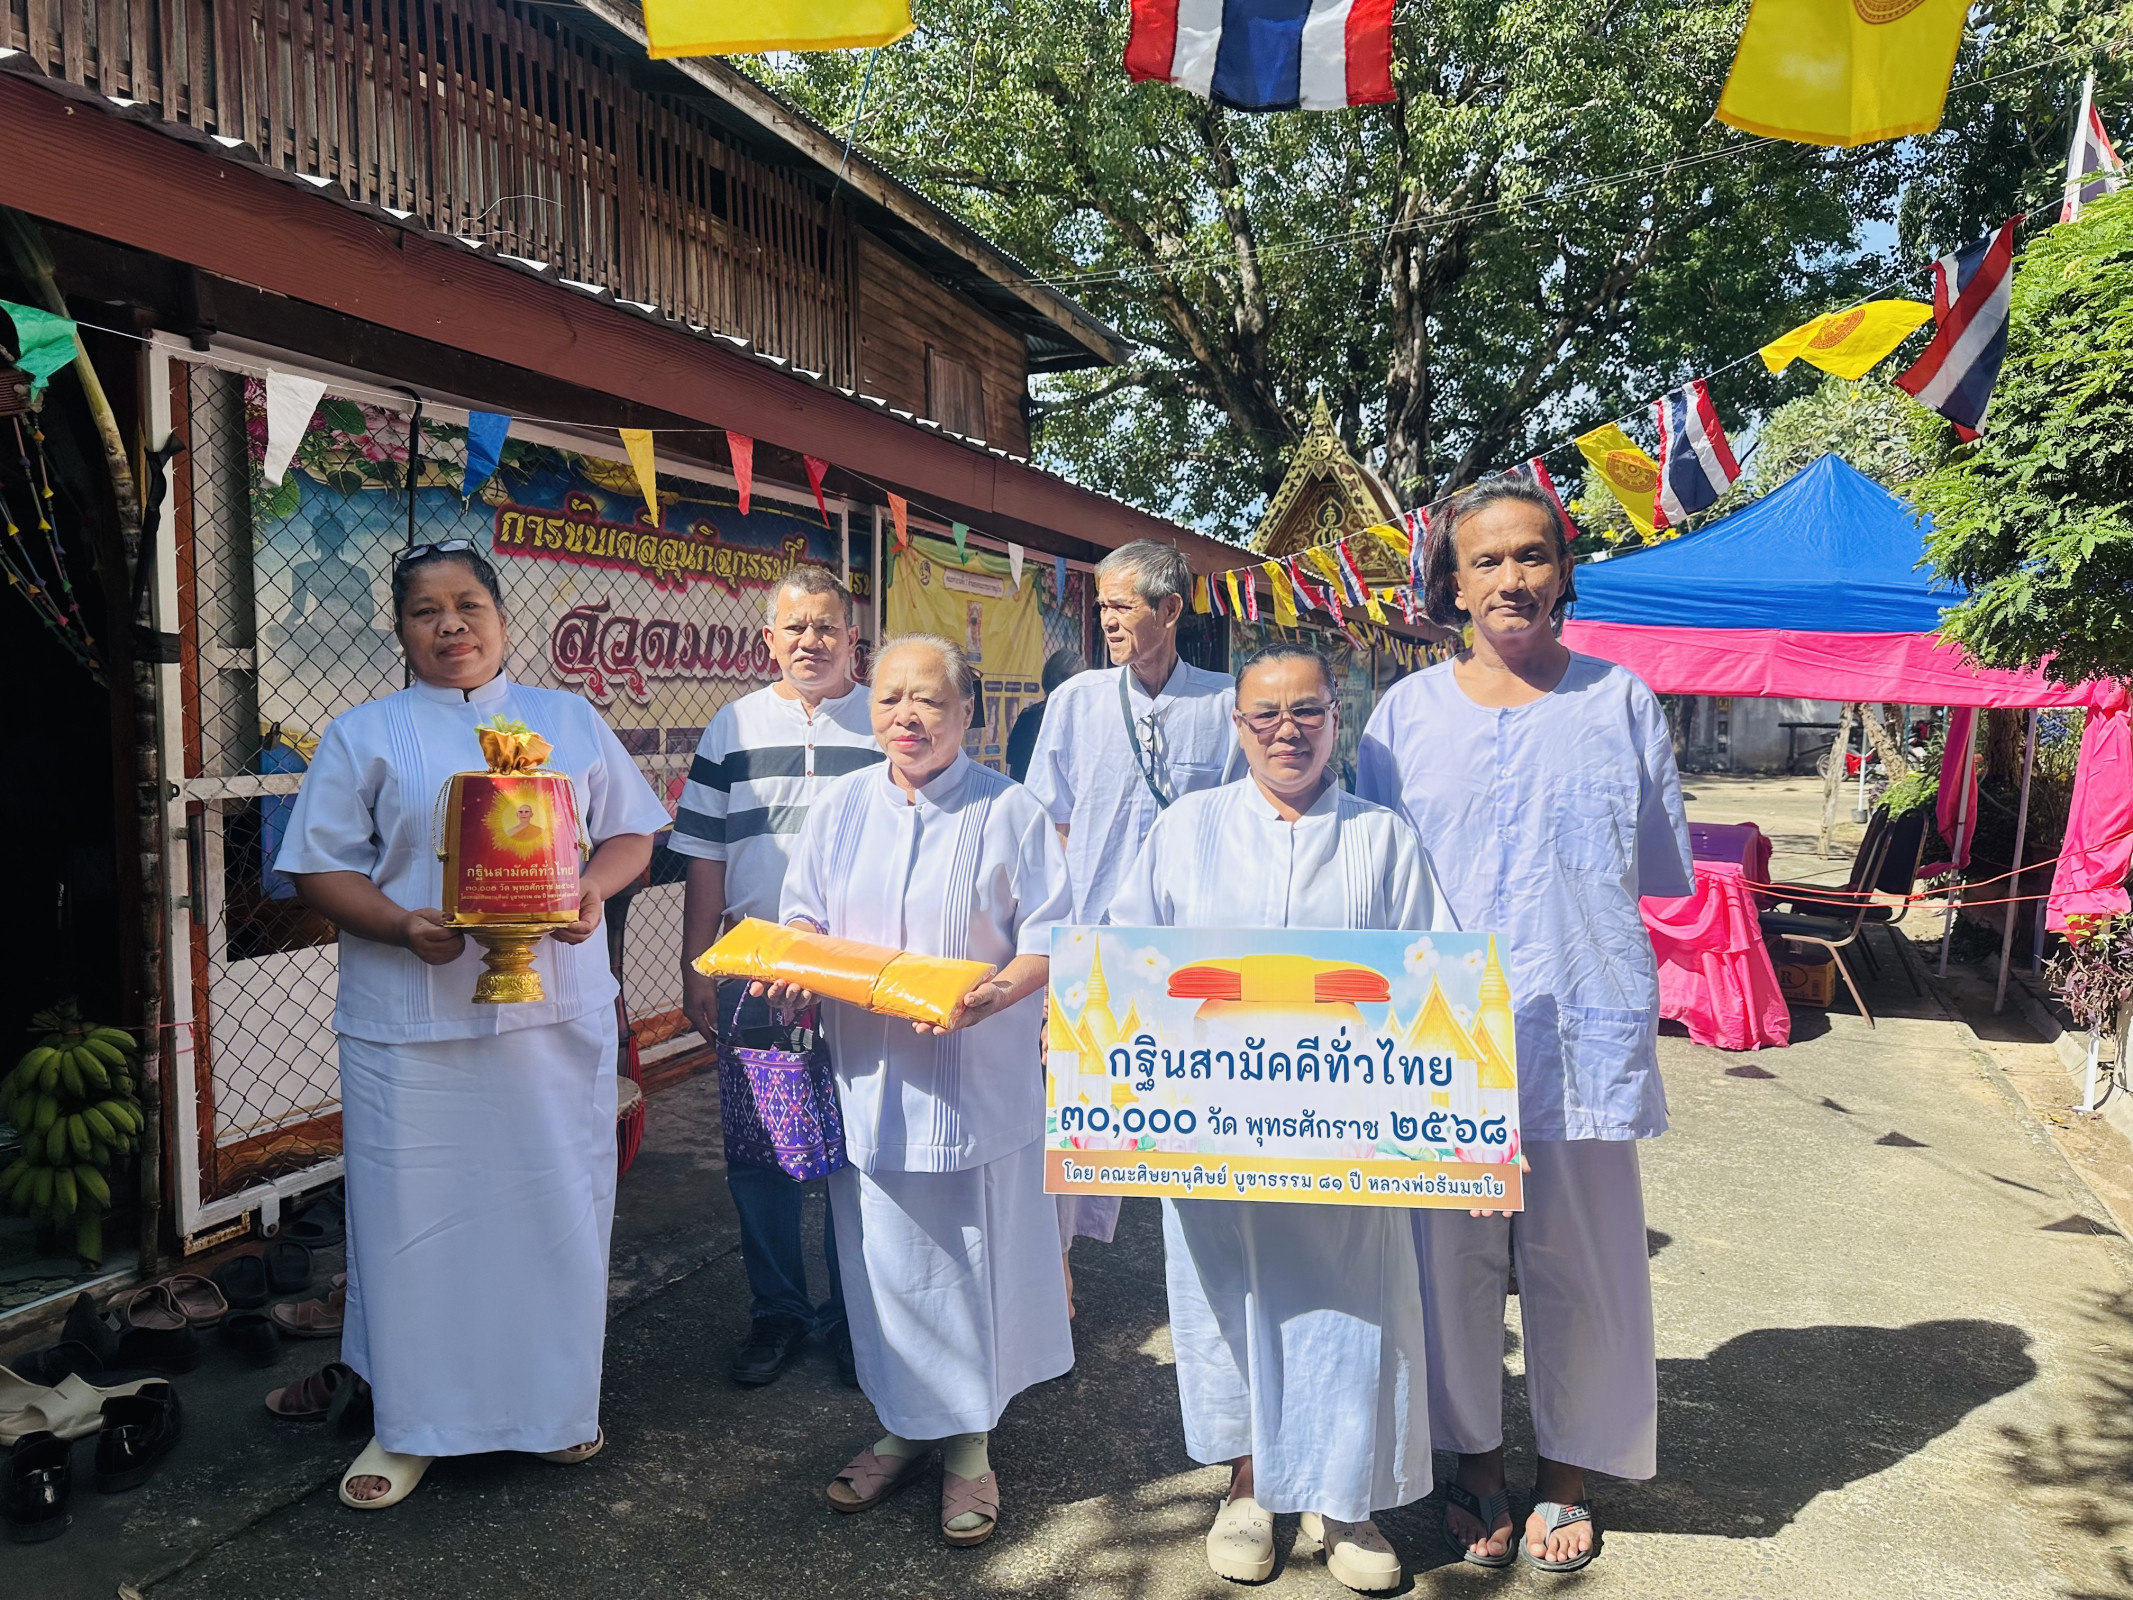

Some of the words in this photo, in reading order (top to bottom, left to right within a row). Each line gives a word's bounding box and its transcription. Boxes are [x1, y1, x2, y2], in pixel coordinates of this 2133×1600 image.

[467, 860, 574, 880] กฐินสามัคคีทั่วไทย
[499, 883, 510, 891] วัด
[1109, 1026, 1453, 1092] กฐินสามัคคีทั่วไทย
[1061, 1106, 1197, 1139] ๓๐,๐๐๐
[1207, 1105, 1238, 1135] วัด
[1245, 1108, 1379, 1147] พุทธศักราช
[1390, 1111, 1507, 1145] ๒๕๖๘
[1064, 1161, 1094, 1180] โดย
[1100, 1164, 1228, 1189] คณะศิษยานุศิษย์
[1234, 1172, 1311, 1192] บูชาธรรม
[1319, 1176, 1343, 1191] ๘๑
[1349, 1170, 1361, 1190] ปี
[1368, 1174, 1504, 1196] หลวงพ่อธัมมชโย
